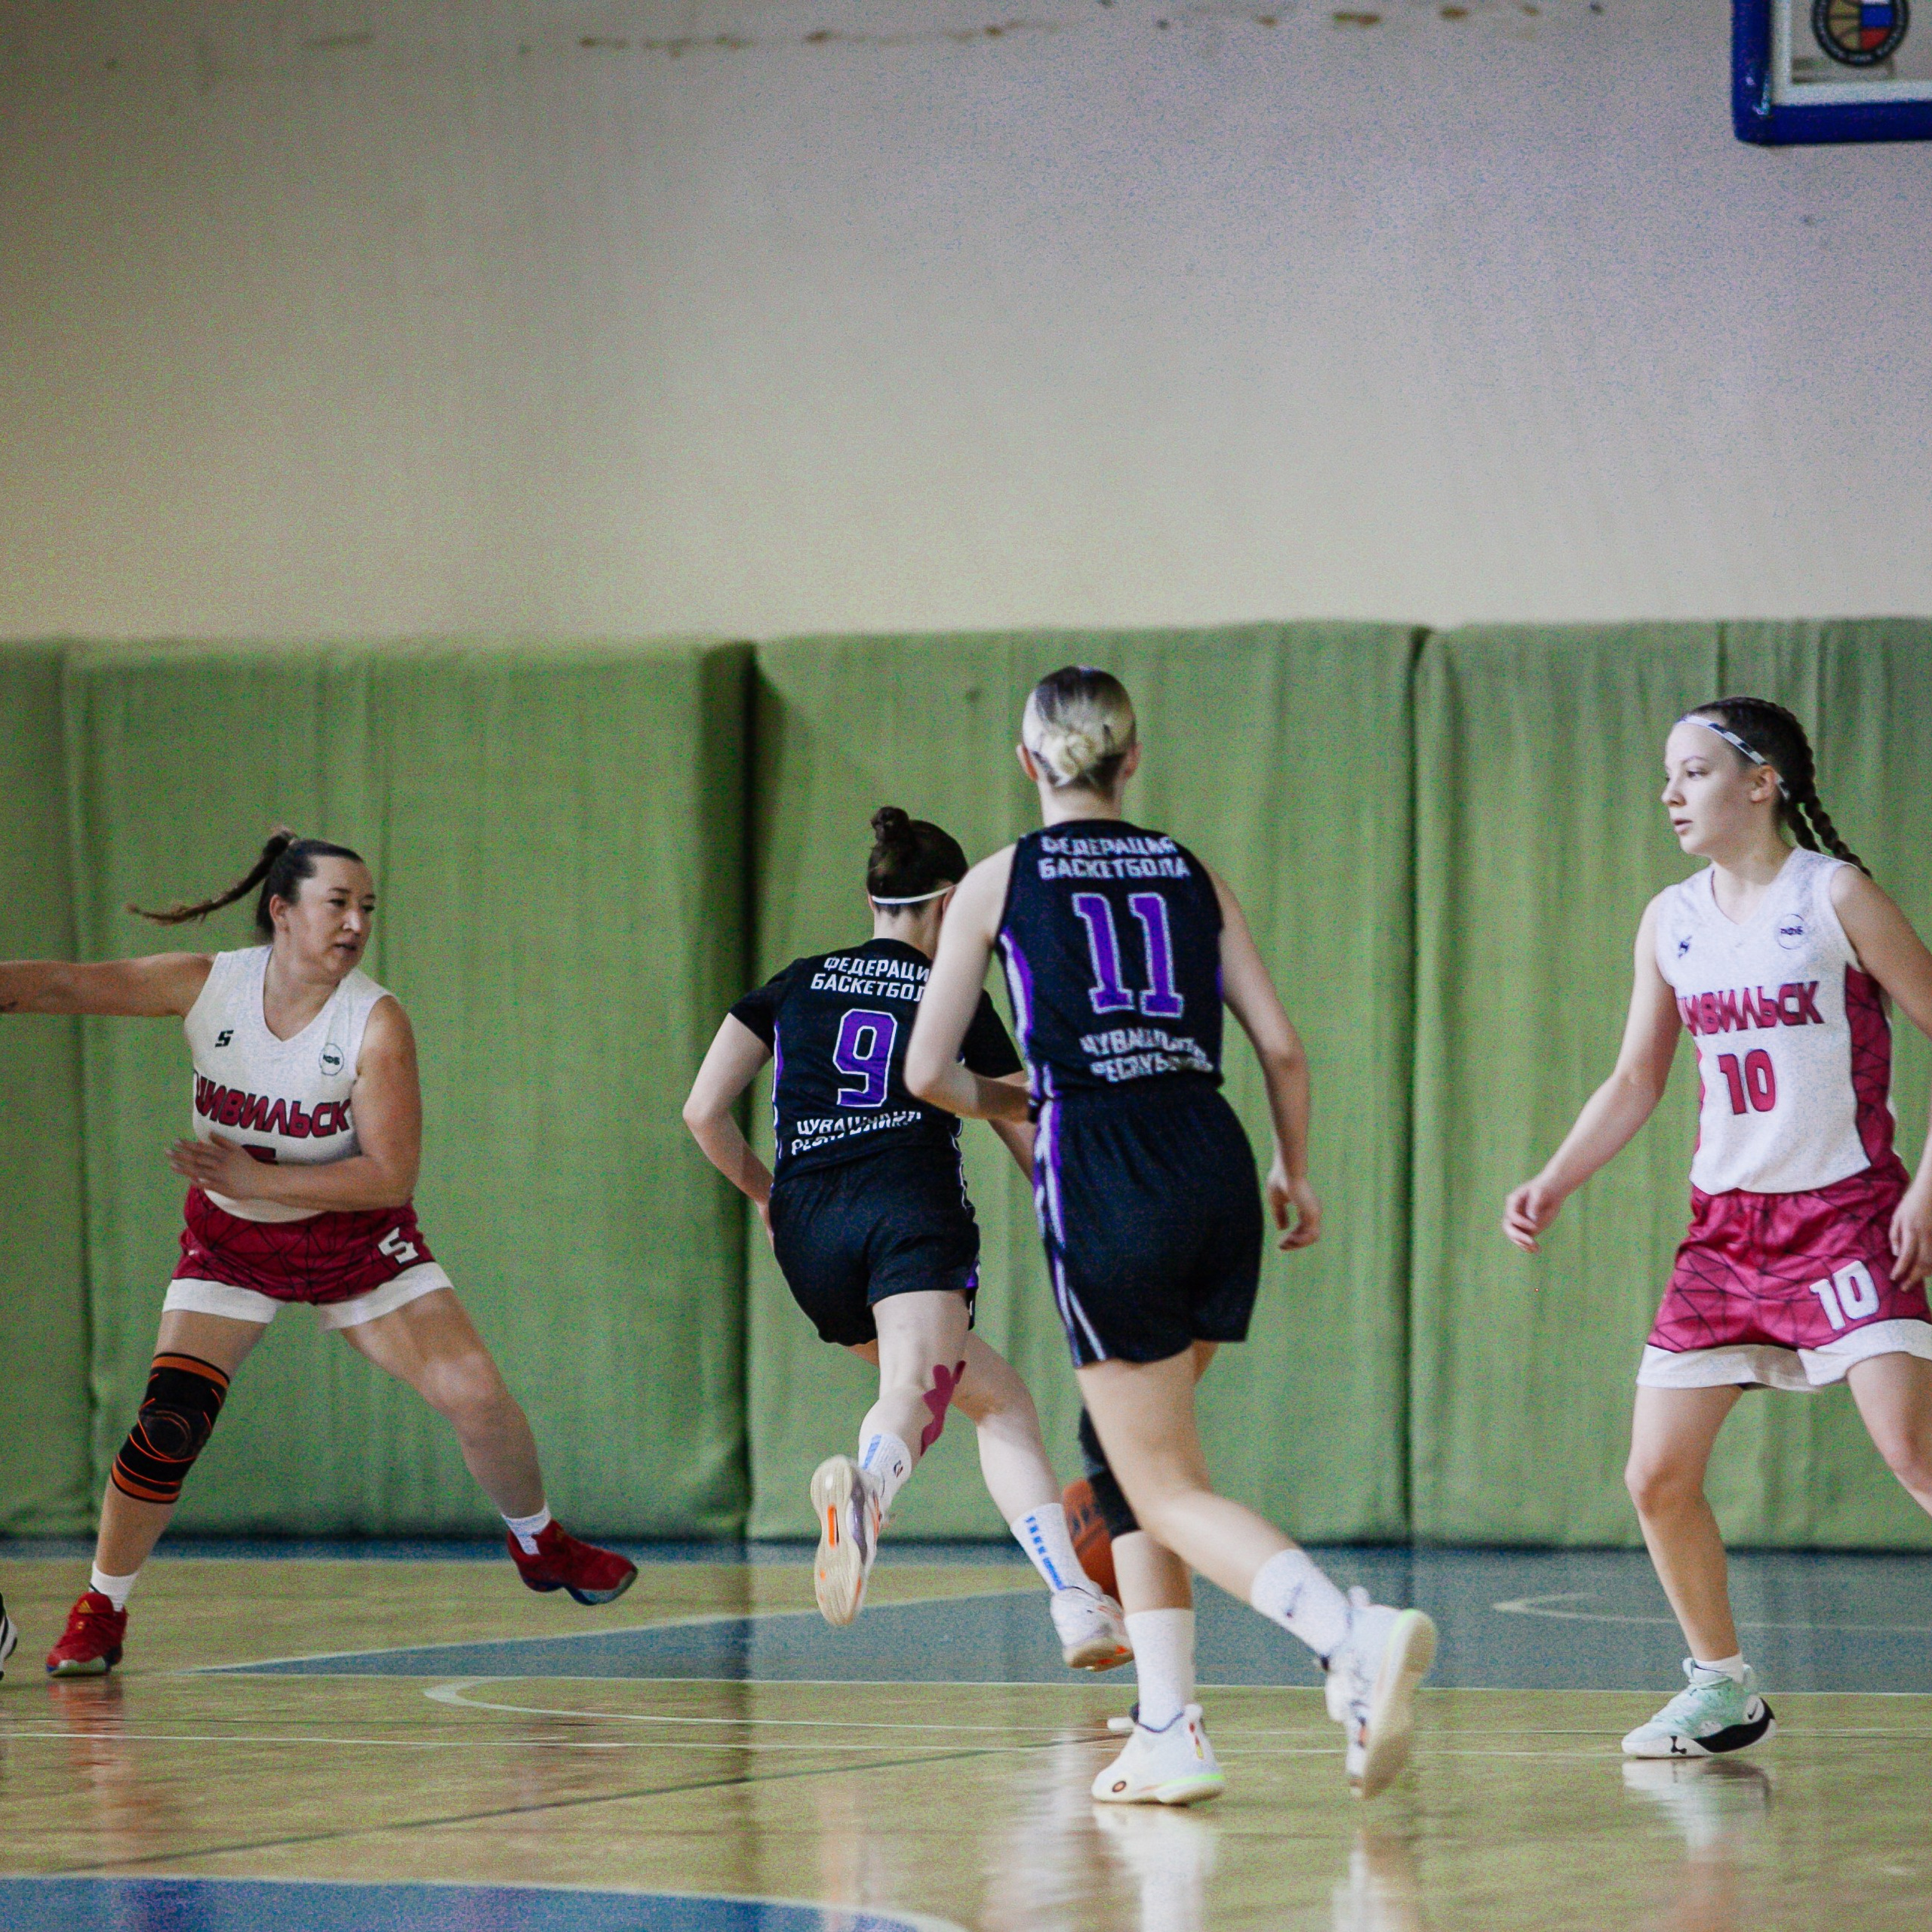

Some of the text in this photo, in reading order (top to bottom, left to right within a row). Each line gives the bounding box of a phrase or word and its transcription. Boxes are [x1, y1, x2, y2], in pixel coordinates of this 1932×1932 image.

[1038, 857, 1191, 880] БАСКЕТБОЛА
[823, 956, 930, 983] ФЕДЕРАЦИ
[1071, 892, 1184, 1020] 11
[810, 973, 926, 1002] БАСКЕТБОЛ
[832, 1008, 898, 1108] 9
[1717, 1048, 1777, 1115] 10
[377, 1226, 419, 1265] 5
[1809, 1260, 1880, 1331] 10
